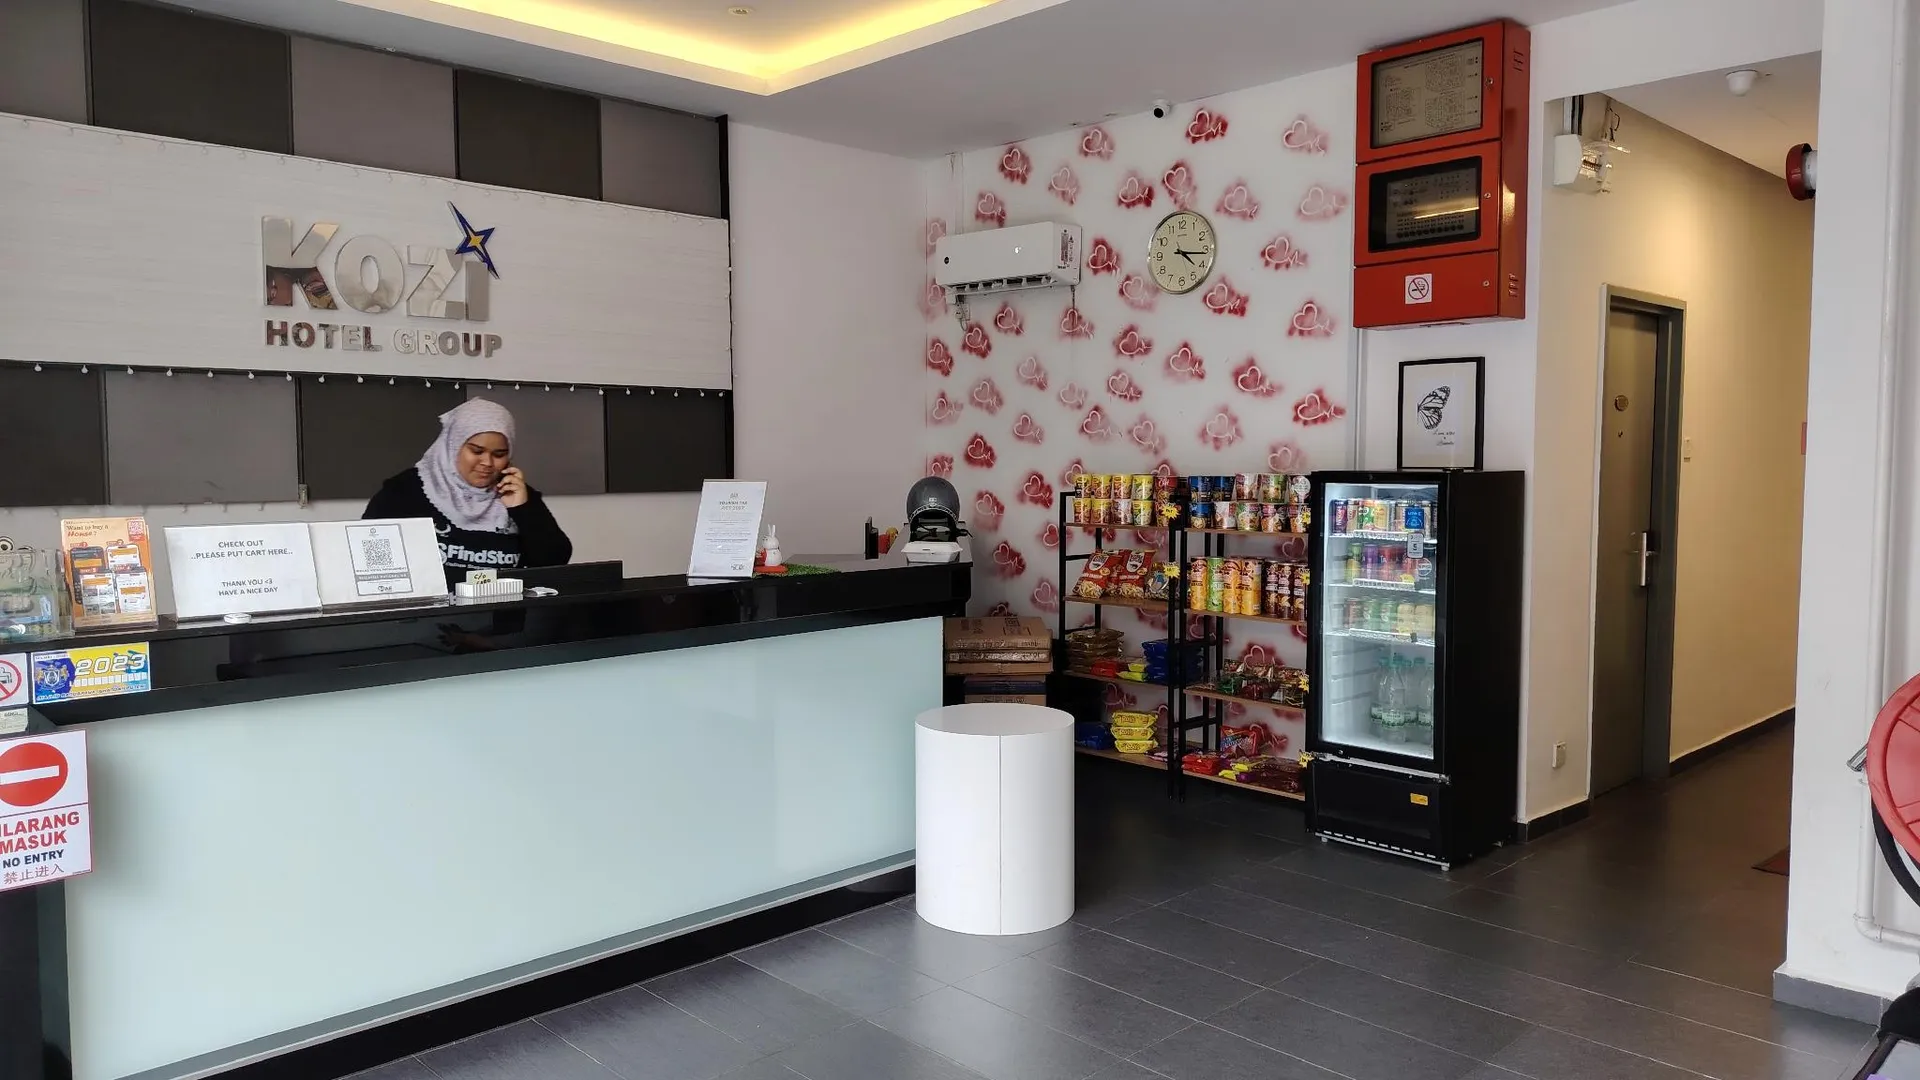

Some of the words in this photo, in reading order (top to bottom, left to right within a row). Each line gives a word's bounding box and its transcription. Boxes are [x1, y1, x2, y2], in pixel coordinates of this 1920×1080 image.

[1168, 225, 1175, 235] 11
[1178, 220, 1186, 230] 12
[1192, 222, 1196, 231] 1
[1199, 231, 1206, 241] 2
[1160, 237, 1168, 247] 10
[1202, 245, 1209, 254] 3
[1156, 251, 1163, 261] 9
[1159, 265, 1166, 274] 8
[1198, 260, 1205, 269] 4
[1168, 274, 1174, 282] 7
[1178, 276, 1186, 286] 6
[1190, 271, 1197, 281] 5
[264, 320, 382, 353] HOTEL
[394, 327, 502, 358] GROUP
[218, 540, 246, 549] CHECK
[246, 539, 264, 547] OUT
[227, 550, 243, 558] PUT
[245, 549, 267, 557] CART
[221, 580, 247, 588] THANK
[218, 589, 238, 597] HAVE
[264, 586, 279, 594] DAY
[74, 654, 147, 677] 2023
[0, 829, 68, 855] MASUK
[3, 857, 21, 869] NO
[24, 849, 65, 865] ENTRY
[4, 863, 65, 885] 禁止进入
